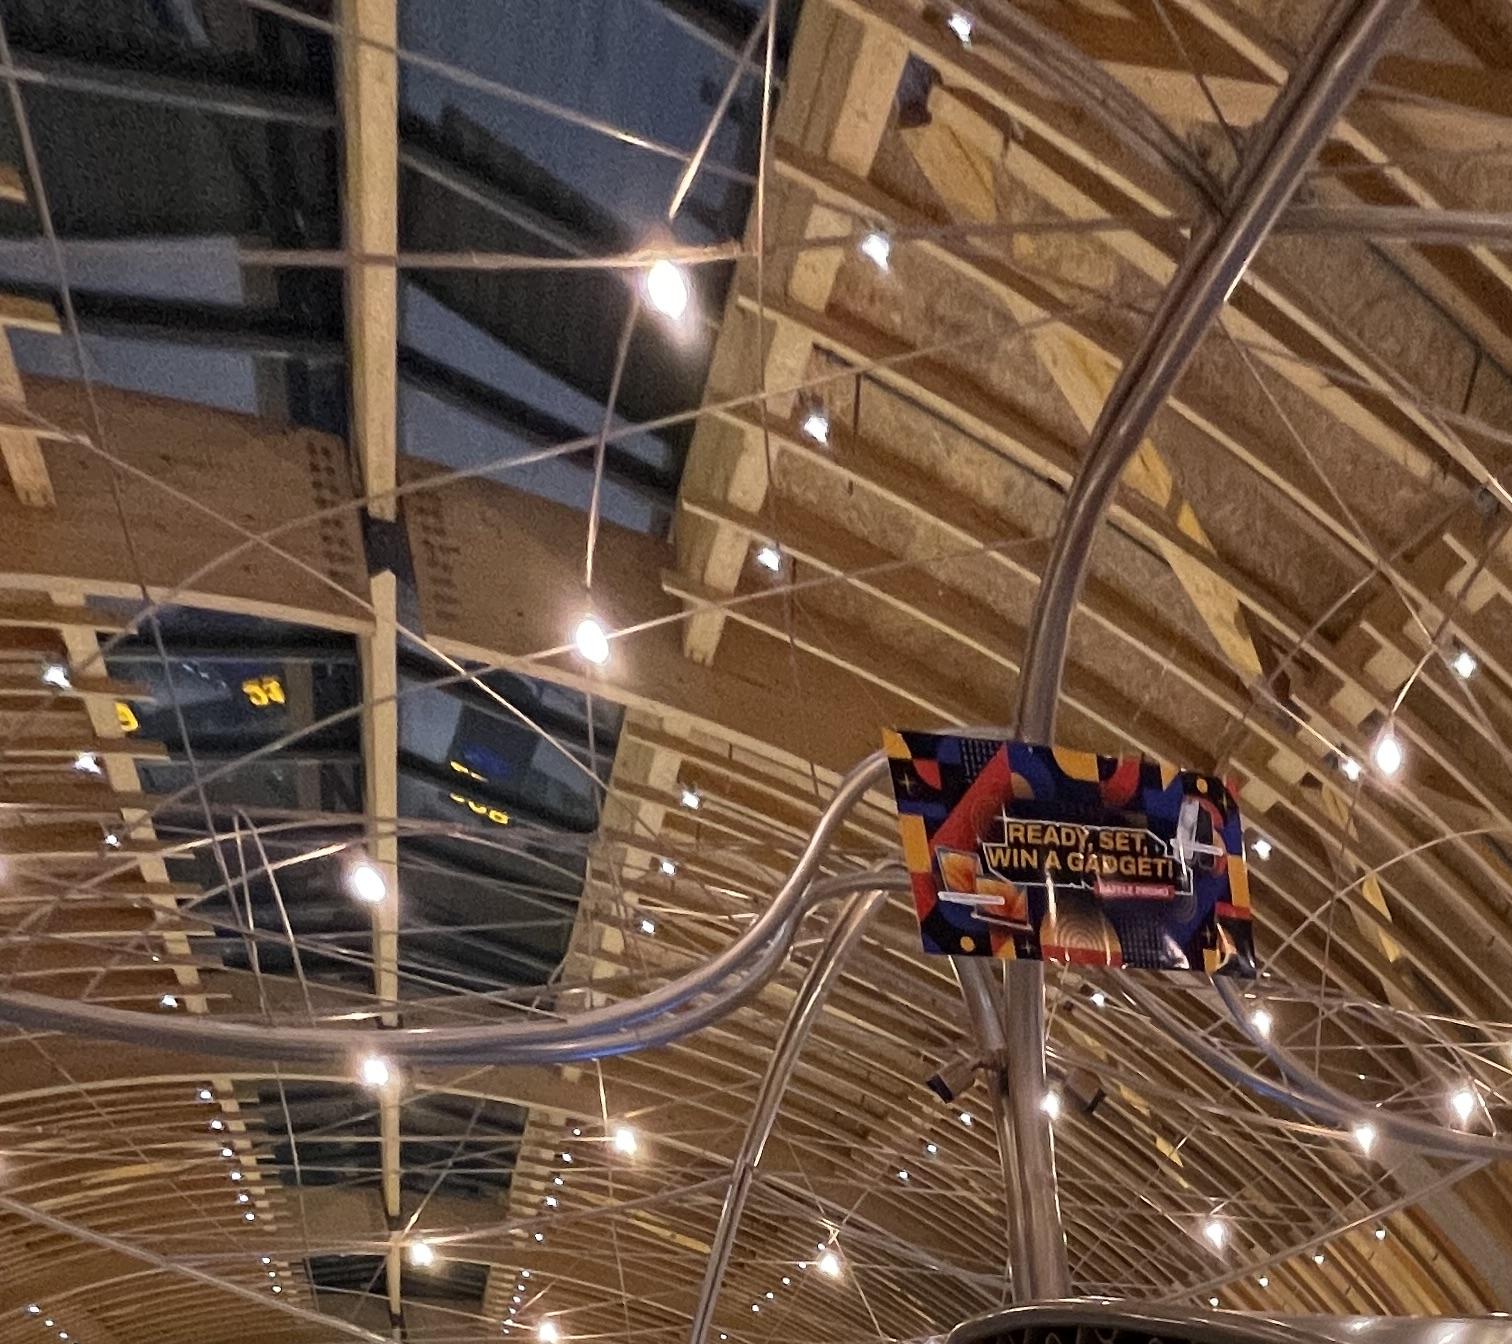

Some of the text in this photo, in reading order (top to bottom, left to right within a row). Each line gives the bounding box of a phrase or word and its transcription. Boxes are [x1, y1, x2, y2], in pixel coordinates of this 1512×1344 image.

[1008, 823, 1148, 855] READY, SET,
[989, 848, 1173, 878] WIN A GADGET!
